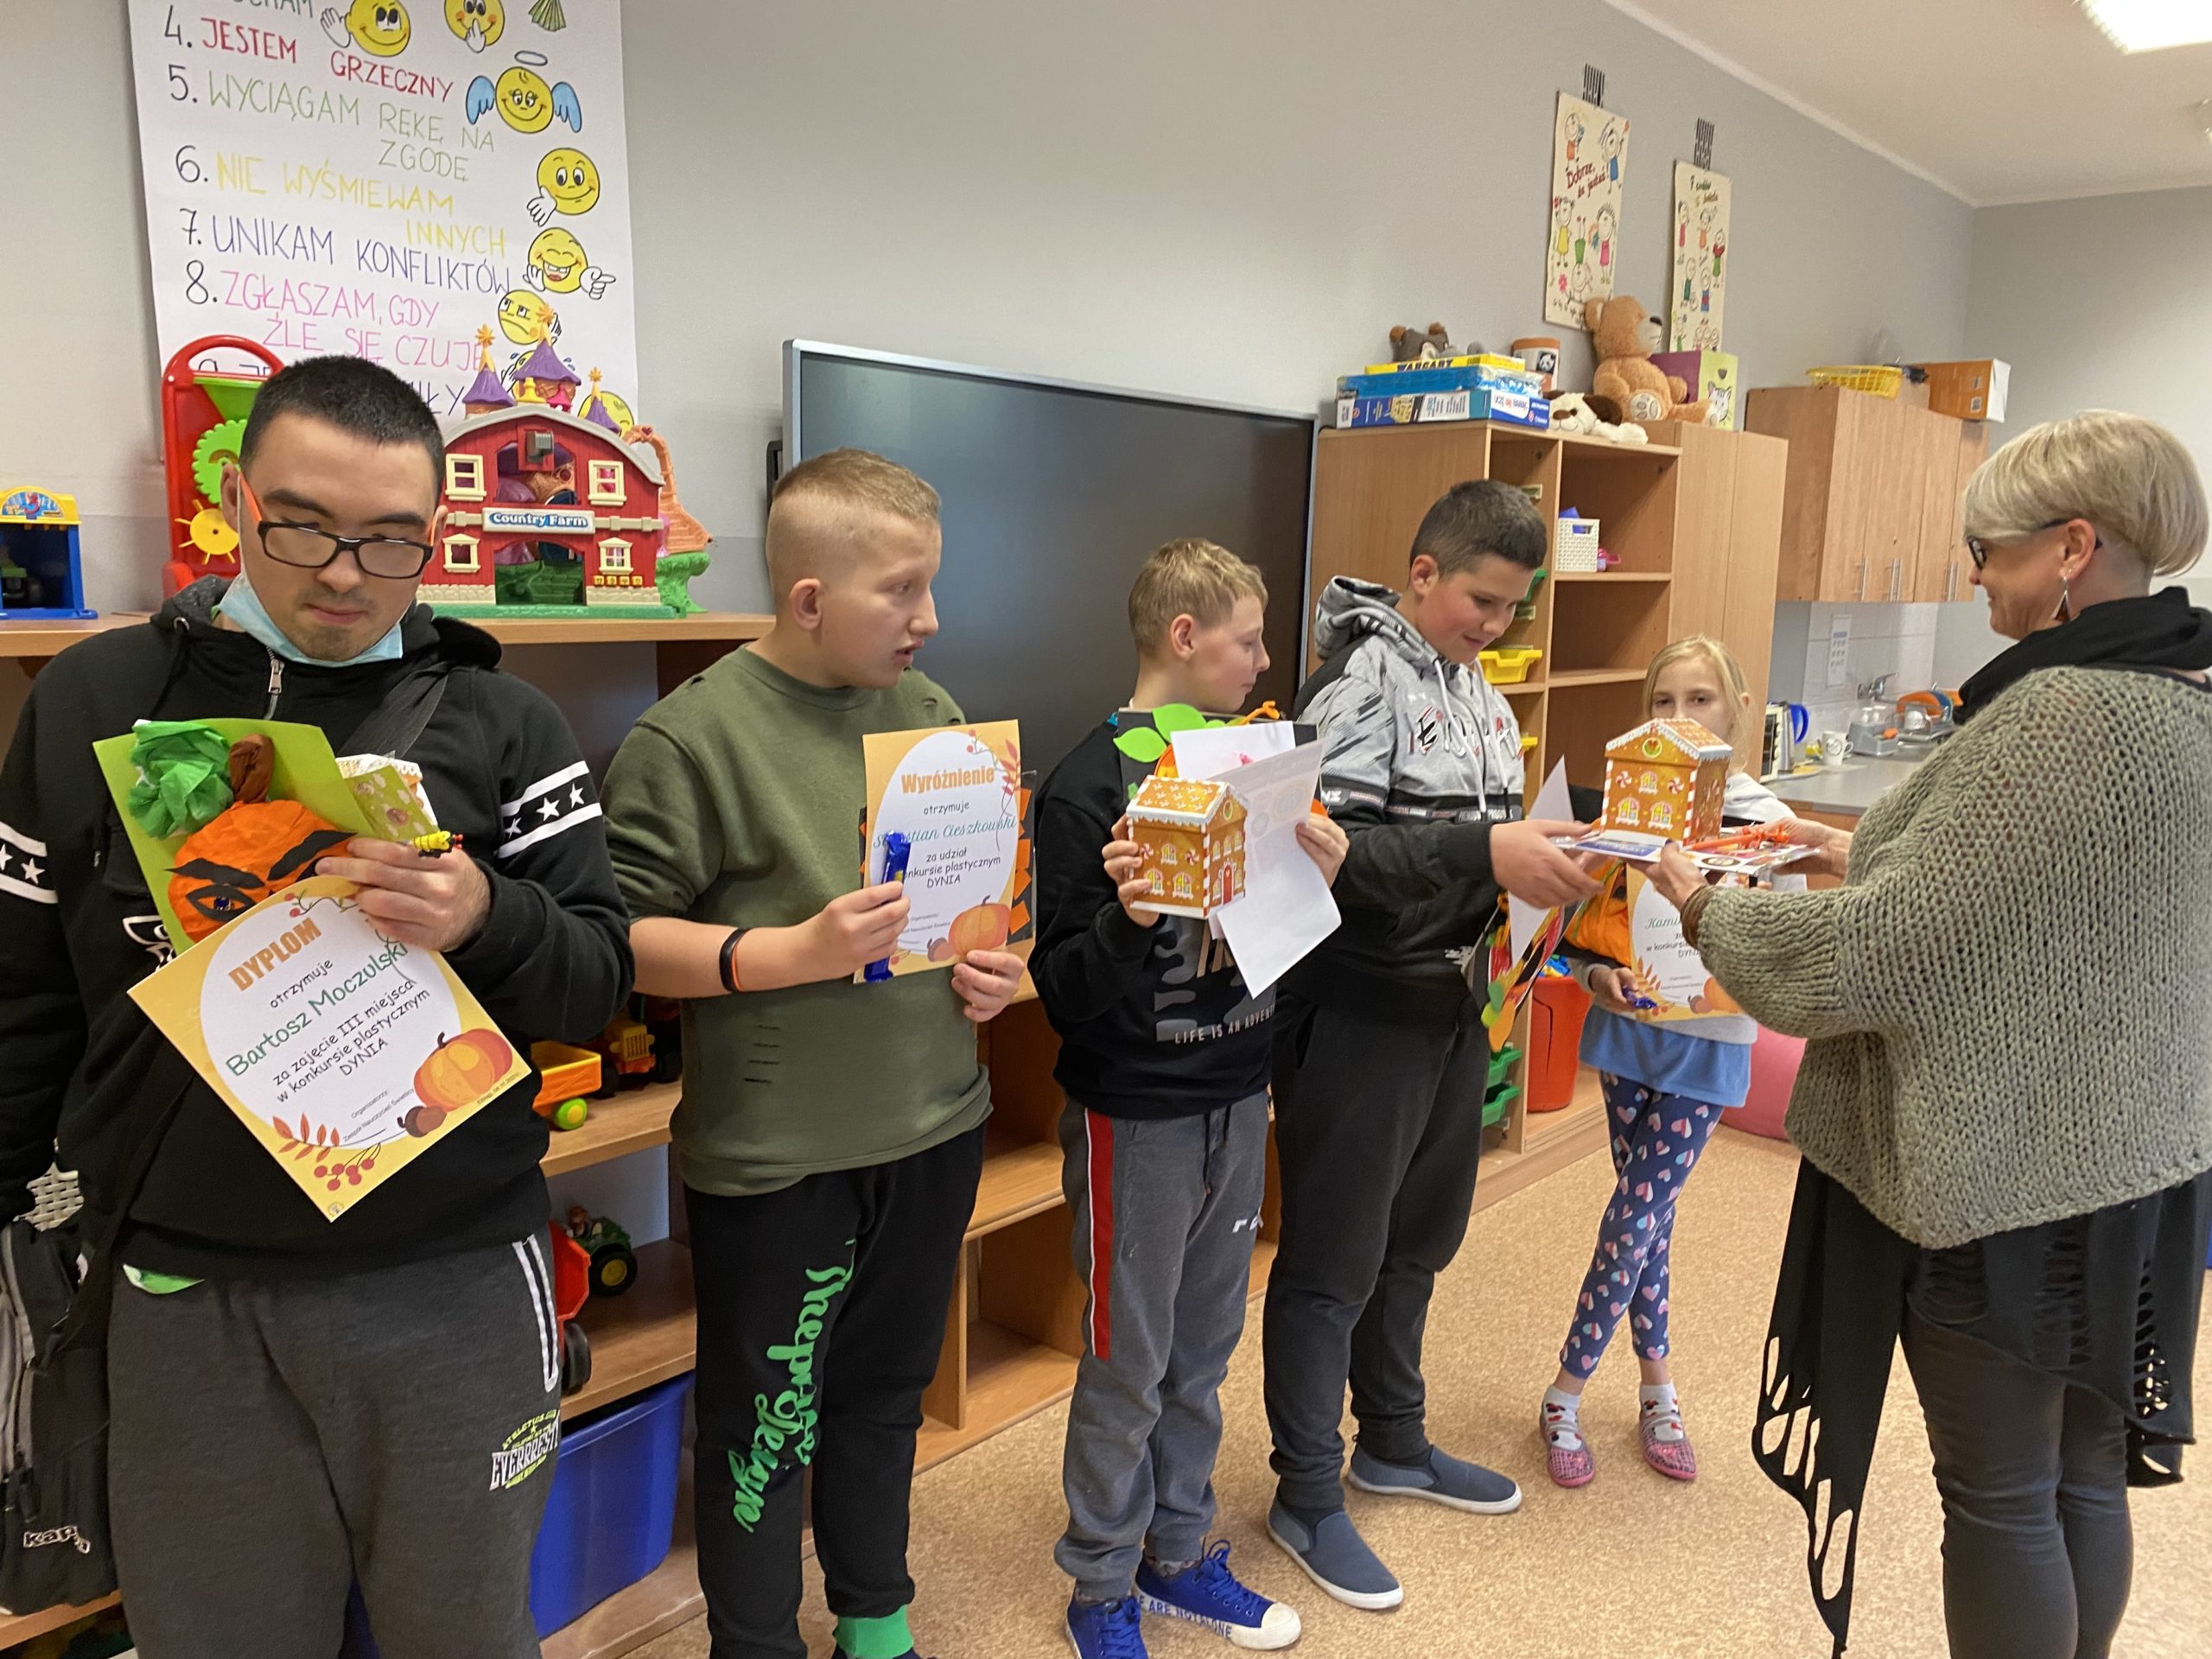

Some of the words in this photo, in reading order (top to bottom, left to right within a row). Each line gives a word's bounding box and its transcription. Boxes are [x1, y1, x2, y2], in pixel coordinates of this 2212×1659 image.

[164, 5, 193, 48] 4.
[200, 17, 296, 64] JESTEM
[330, 50, 454, 103] GRZECZNY
[168, 64, 198, 103] 5.
[208, 70, 359, 125] WYCIĄGAM
[379, 102, 443, 145] RĘKĘ
[461, 126, 494, 152] NA
[175, 145, 208, 183] 6.
[216, 151, 267, 194] NIE
[282, 157, 454, 215] WYŚMIEWAM
[378, 139, 469, 182] ZGODĘ
[180, 207, 202, 245] 7.
[213, 214, 333, 264] UNIKAM
[356, 238, 510, 295] KONFLIKTÓW
[406, 219, 505, 258] INNYCH
[186, 259, 218, 305] 8.
[389, 295, 439, 328] GDY
[492, 512, 547, 527] Country
[548, 514, 588, 527] Farm
[900, 766, 995, 794] Wyróżnienie
[923, 799, 969, 815] otrzymuje
[906, 866, 943, 879] onkursie
[945, 856, 1001, 873] plastycznym
[926, 854, 937, 863] za
[939, 847, 967, 861] udział
[926, 874, 961, 888] DYNIA
[228, 918, 322, 991] DYPLOM
[270, 960, 334, 1008] otrzymuje
[226, 1013, 313, 1076] Bartosz
[308, 943, 408, 1016] Moczulski
[273, 1071, 290, 1085] za
[291, 1034, 339, 1072] zajęcie
[337, 1014, 365, 1037] III
[364, 980, 414, 1018] miejsca
[276, 1090, 289, 1103] w
[289, 1044, 353, 1093] konkursie
[353, 989, 430, 1049] plastycznym
[1175, 1027, 1205, 1045] LIFE
[1211, 1023, 1223, 1039] IS
[1228, 1020, 1240, 1034] AN
[339, 1038, 389, 1076] DYNIA
[1148, 1599, 1171, 1615] ARE
